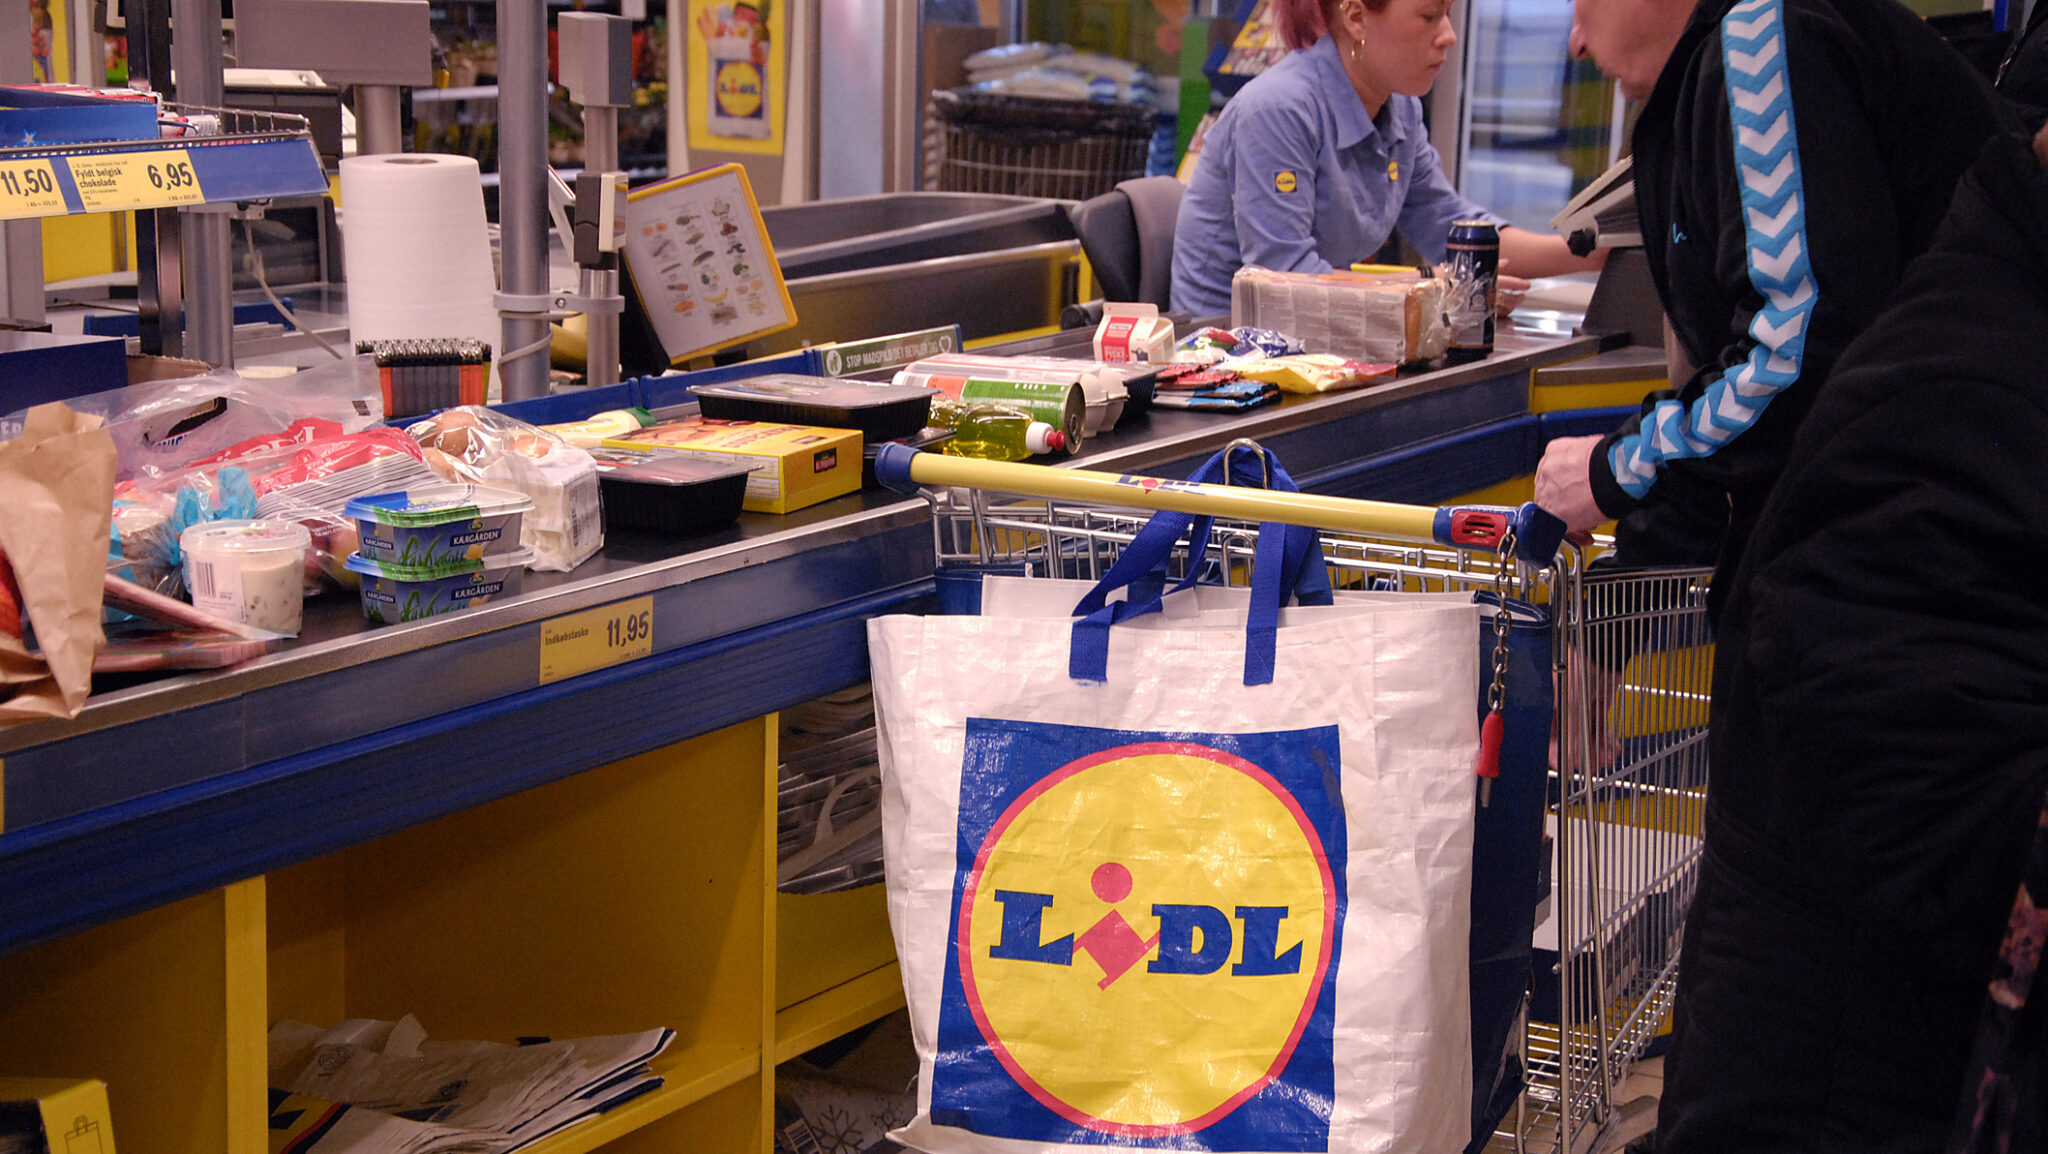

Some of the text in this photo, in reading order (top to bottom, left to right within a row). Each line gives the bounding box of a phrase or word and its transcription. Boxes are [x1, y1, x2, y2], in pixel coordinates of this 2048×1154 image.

[0, 168, 53, 196] 11,50
[75, 166, 123, 181] Fyldt belgisk
[79, 178, 117, 188] chokolade
[147, 162, 193, 190] 6,95
[846, 354, 862, 368] STOP
[862, 349, 893, 365] MADSPILD
[453, 530, 499, 545] KÆRGÅRDEN
[455, 584, 501, 599] KÆRGÅRDEN
[607, 610, 650, 648] 11,95
[989, 862, 1304, 991] LIDL
